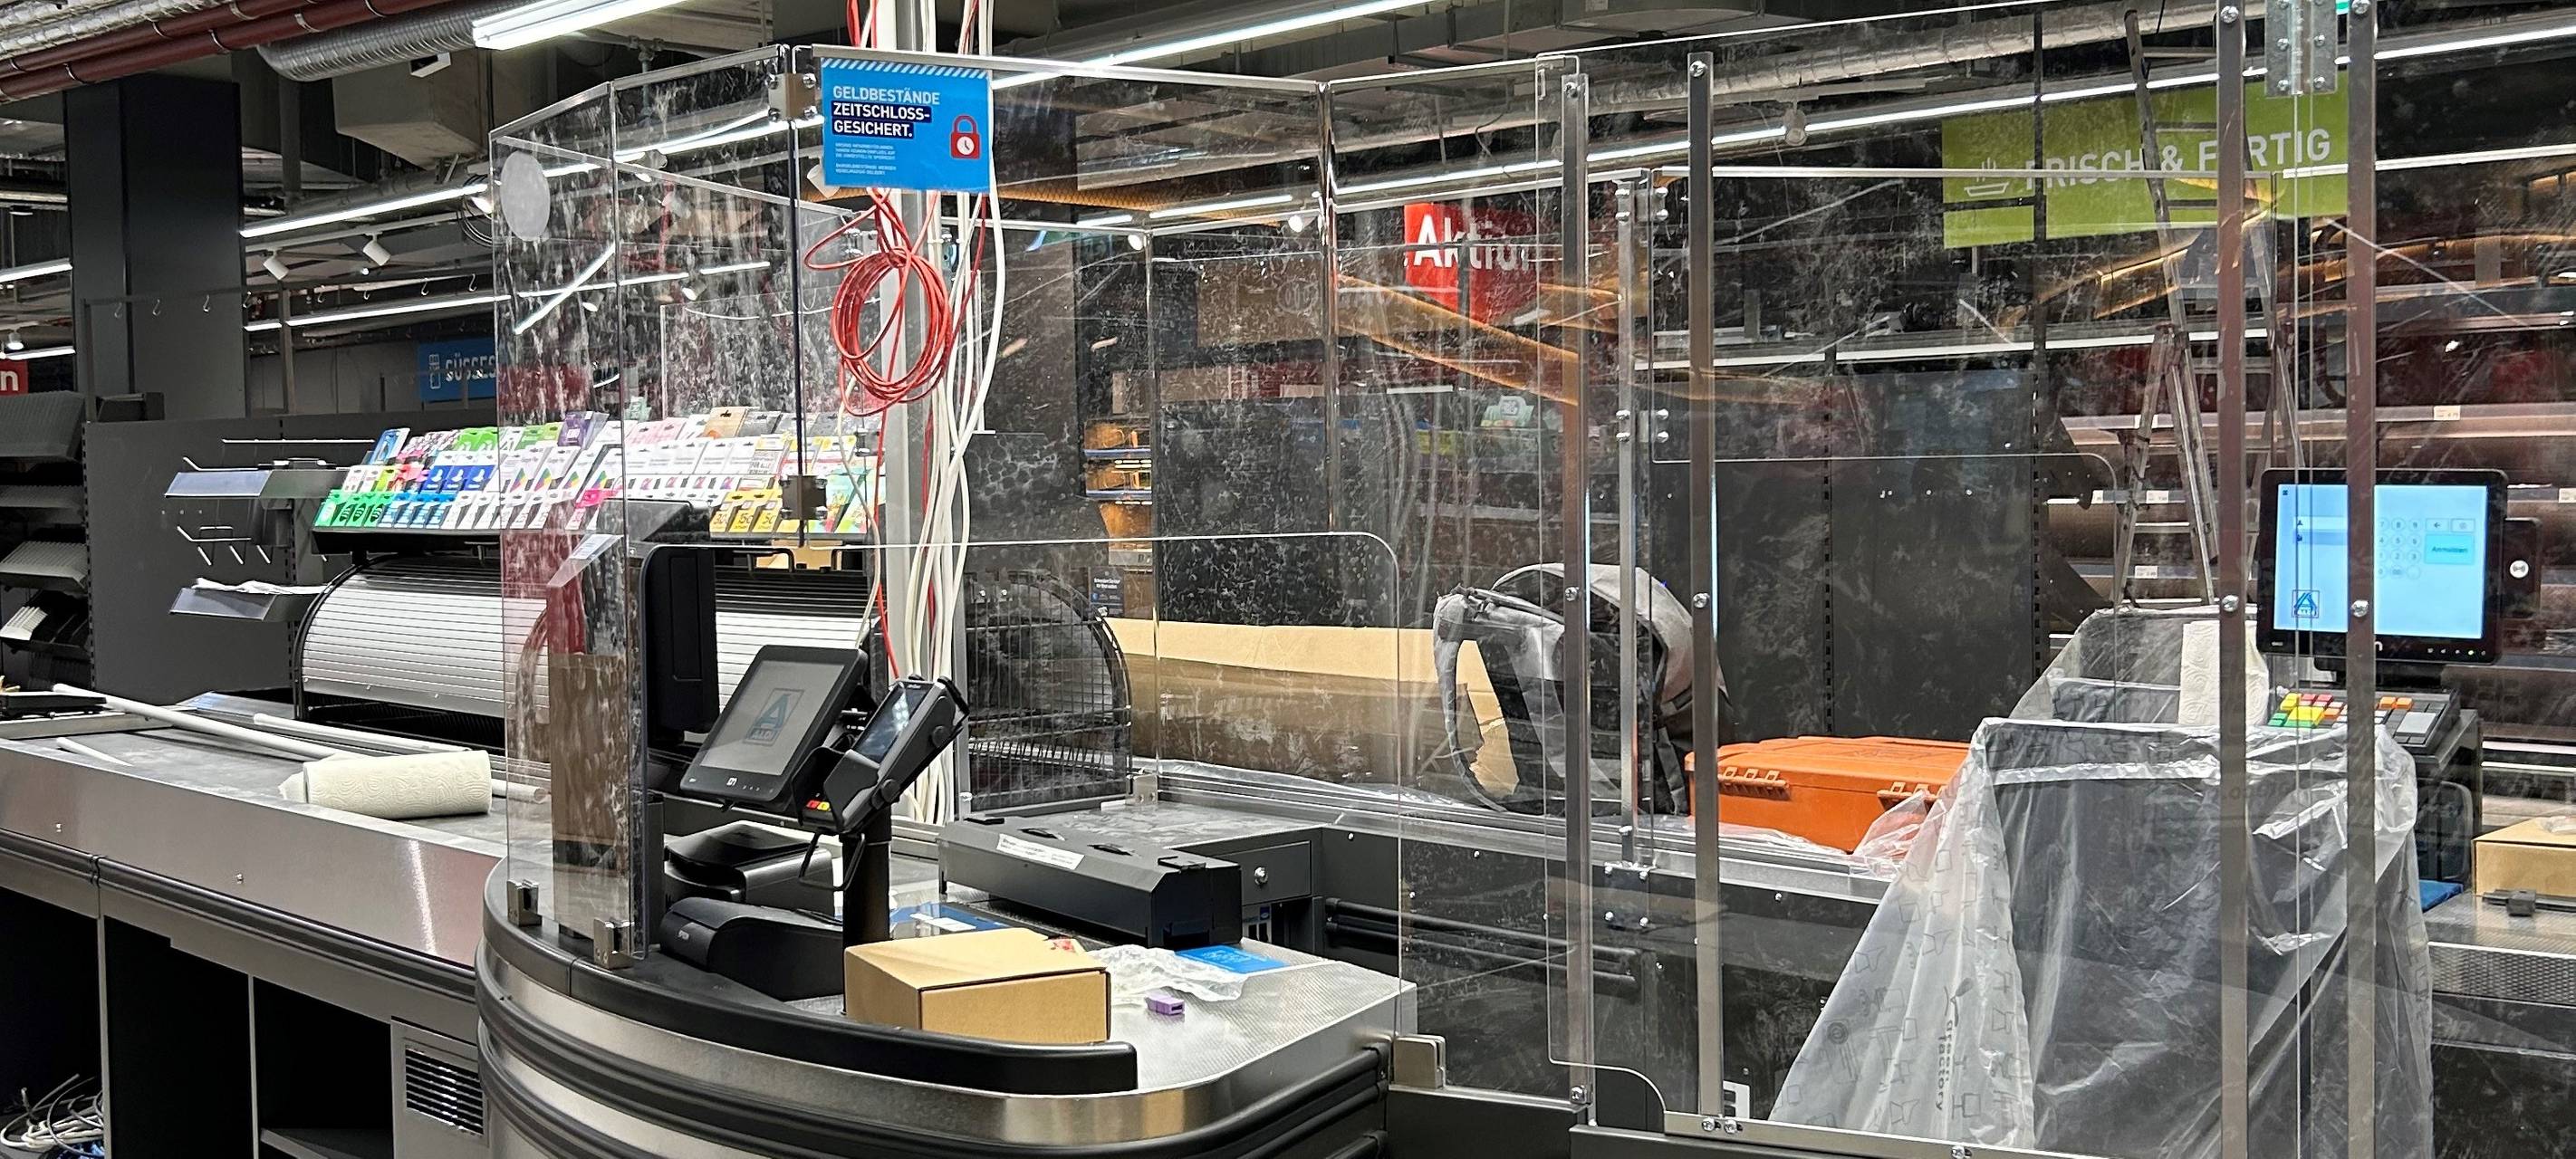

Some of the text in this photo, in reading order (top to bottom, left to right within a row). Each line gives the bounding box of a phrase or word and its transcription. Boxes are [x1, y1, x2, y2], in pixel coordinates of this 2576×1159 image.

[832, 85, 941, 105] GELDBESTÄNDE
[832, 101, 930, 120] ZEITSCHLOSS-
[833, 120, 913, 138] GESICHERT.
[2025, 129, 2331, 190] FRISCH & FRTIG
[1936, 1035, 1946, 1110] factory
